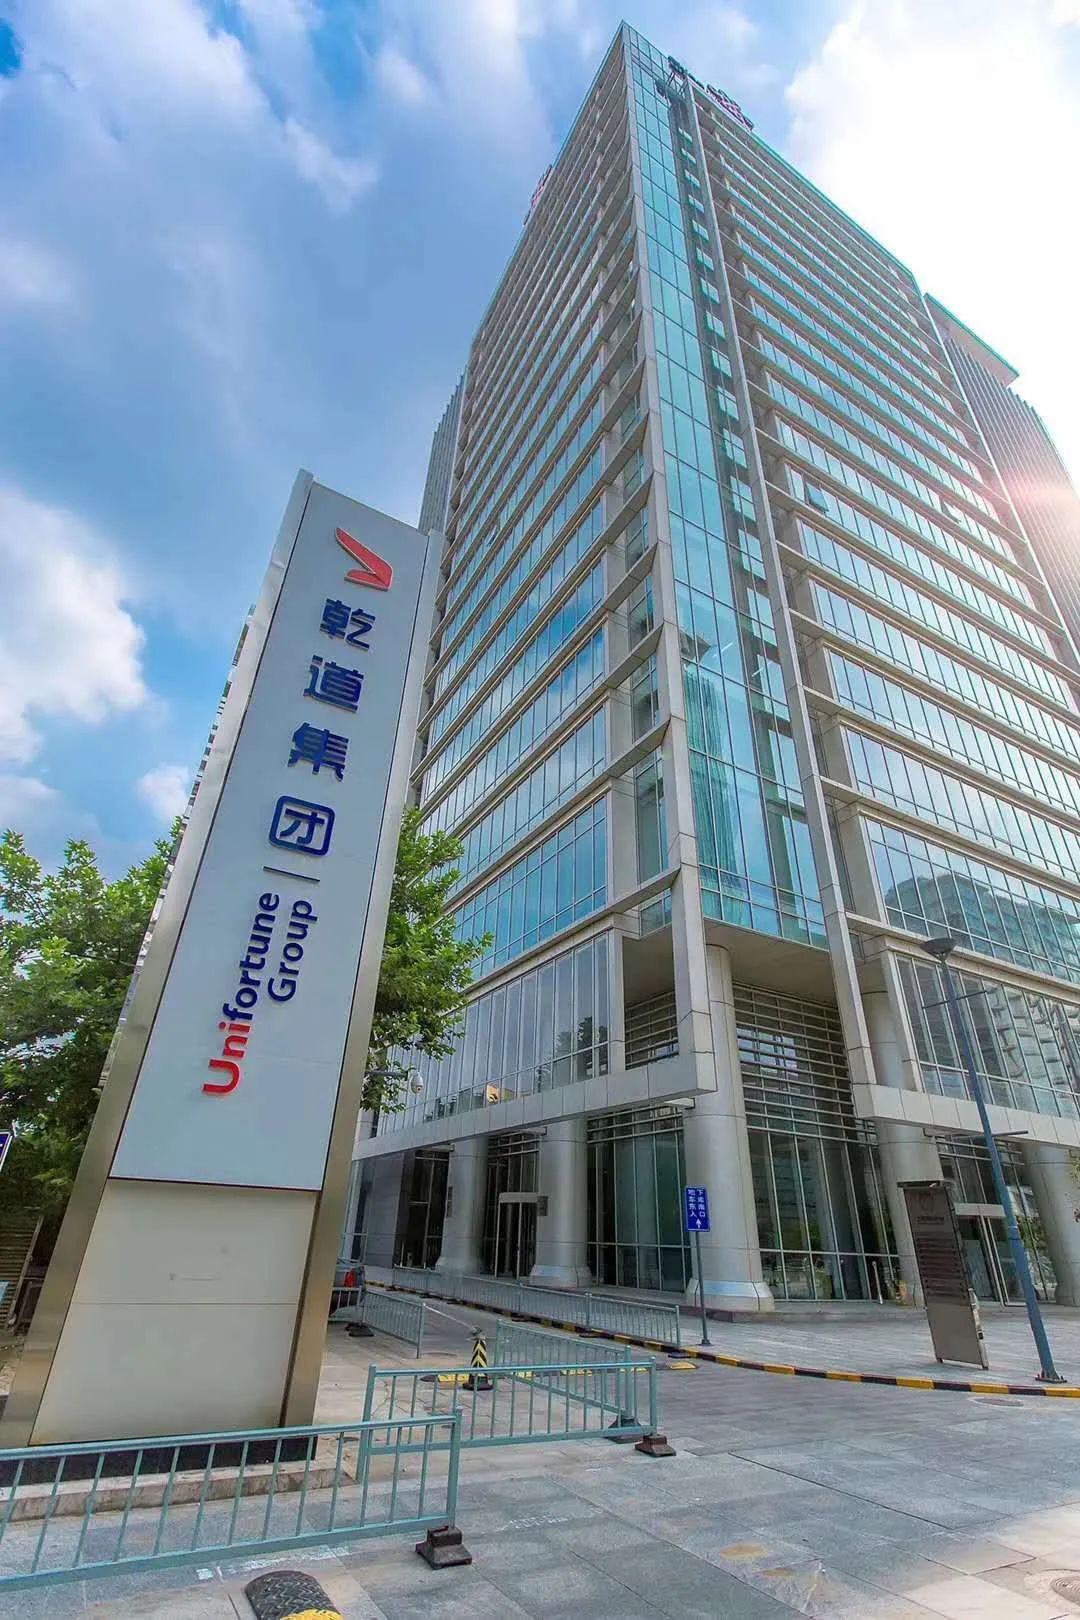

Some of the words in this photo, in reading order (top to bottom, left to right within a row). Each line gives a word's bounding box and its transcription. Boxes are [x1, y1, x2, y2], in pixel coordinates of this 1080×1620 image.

[269, 598, 376, 857] 乾道集团
[203, 892, 280, 1096] Unifortune
[267, 900, 318, 1002] Group
